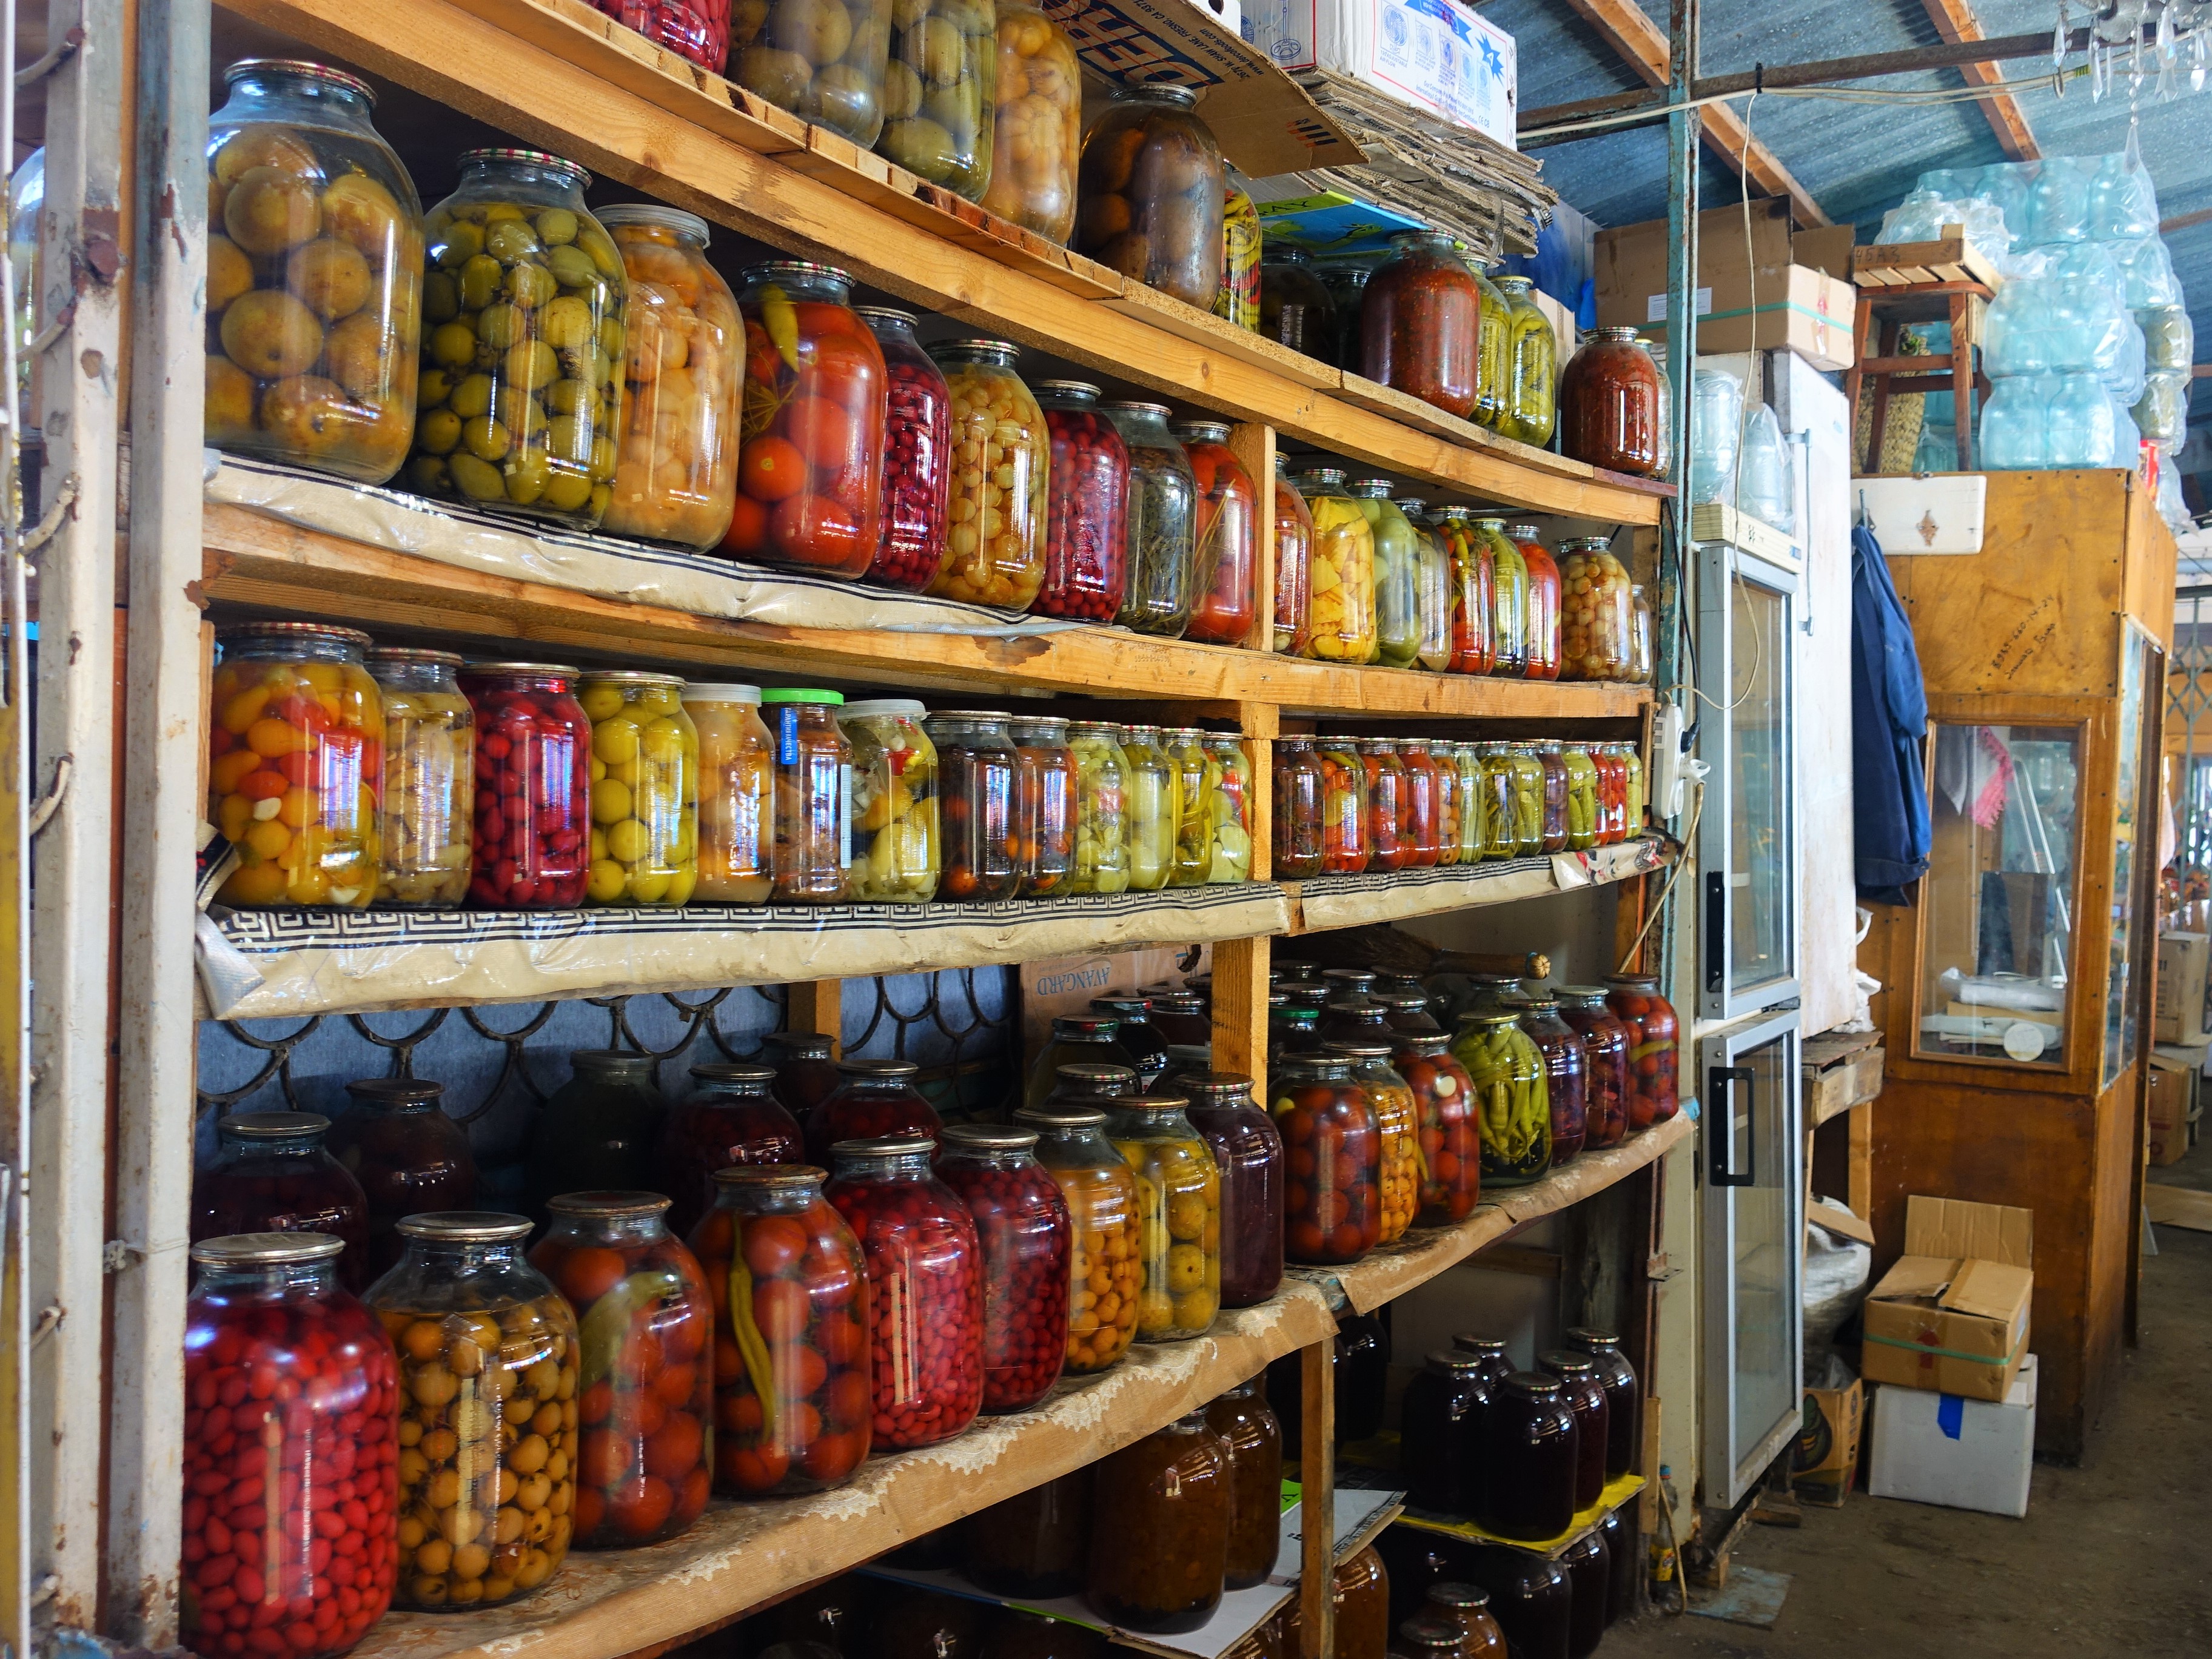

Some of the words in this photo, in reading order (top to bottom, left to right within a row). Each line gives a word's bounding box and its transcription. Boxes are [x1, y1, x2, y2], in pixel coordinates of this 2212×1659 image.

[1151, 11, 1164, 19] CA
[1206, 49, 1226, 62] SHAW
[1037, 967, 1110, 996] AVANGARD
